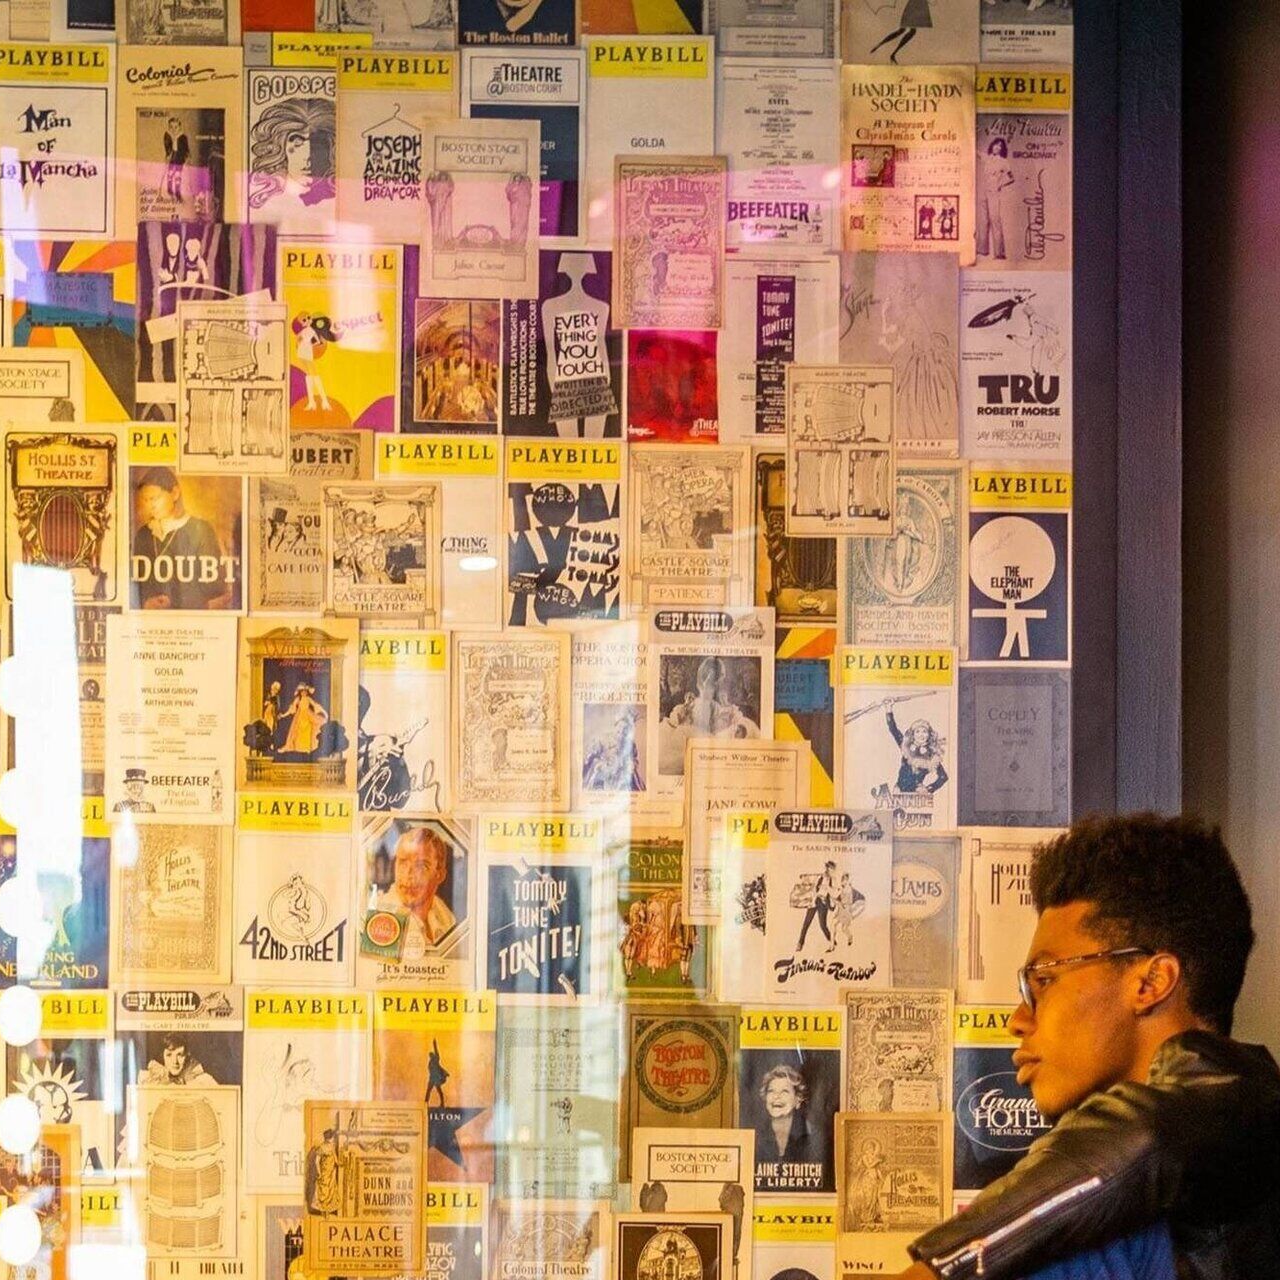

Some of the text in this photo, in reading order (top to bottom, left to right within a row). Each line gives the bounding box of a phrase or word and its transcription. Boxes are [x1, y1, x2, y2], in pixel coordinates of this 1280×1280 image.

[464, 32, 568, 44] The Boston Ballet
[595, 47, 703, 63] PLAYBILL
[343, 58, 449, 75] PLAYBILL
[975, 76, 1066, 94] LAYBILL
[871, 99, 939, 113] SOCIETY
[18, 103, 71, 134] Man
[630, 138, 665, 148] GOLDA
[856, 129, 957, 142] Christmas Carols
[365, 133, 422, 155] JOSEPH
[441, 143, 519, 153] BOSTON STAGE
[457, 154, 505, 166] SOCIETY
[18, 159, 98, 190] Mancha
[727, 201, 809, 223] BEEFEATER
[287, 252, 393, 270] PLAYBILL
[555, 313, 599, 331] EVERY
[558, 329, 597, 343] THING
[559, 344, 598, 360] YOU
[25, 368, 61, 378] STAGE
[556, 360, 604, 377] TOUCH
[978, 374, 1060, 404] TRU
[977, 407, 1061, 416] ROBERT MORSE
[1033, 431, 1061, 441] ALLEN
[27, 452, 76, 467] HOLLIS
[292, 448, 353, 465] UBERT
[385, 444, 494, 460] PLAYBILL
[512, 449, 617, 464] PLAYBILL
[34, 467, 93, 480] THEATRE
[971, 477, 1067, 494] LAYBILL
[572, 527, 619, 546] TOMMY
[570, 546, 620, 566] TOMMY
[130, 555, 240, 584] DOUBT
[1004, 566, 1020, 577] THE
[567, 566, 620, 592] TOMMY
[990, 577, 1034, 589] ELEPHANT
[334, 592, 424, 602] CASTLE SQUARE
[1003, 588, 1022, 600] MAN
[353, 603, 407, 611] THEATRE
[671, 612, 729, 632] PLAYBILL
[360, 640, 441, 656] AYBILL
[133, 651, 206, 662] ANNE BANCROFT
[845, 655, 949, 671] PLAYBILL
[155, 668, 184, 677] GOLDA
[141, 687, 199, 695] WILLIAM GIBSON
[144, 699, 195, 708] ARTHUR PENN
[151, 776, 210, 787] BEEFEATER
[243, 800, 350, 818] PLAYBILL
[489, 822, 595, 838] PLAYBILL
[791, 814, 848, 833] PLAYBILL
[513, 878, 567, 901] TOMMY
[900, 875, 942, 898] JAMES
[513, 906, 548, 929] TUNE
[239, 914, 347, 963] 42ND STREET
[499, 928, 581, 980] TONITE!
[138, 992, 196, 1011] PLAYBILL
[255, 1000, 363, 1015] PLAYBILL
[383, 998, 489, 1013] PLAYBILL
[652, 1040, 706, 1064] BOSTON
[430, 1113, 461, 1121] ILTON
[974, 1108, 1053, 1129] HOTEL
[656, 1153, 732, 1163] BOSTON STAGE
[669, 1163, 717, 1175] SOCIETY
[782, 1163, 822, 1177] STRITCH
[364, 1178, 391, 1189] DUNN
[765, 1178, 820, 1187] LIBERTY
[328, 1226, 403, 1242] PALACE
[329, 1245, 403, 1258] THEATRE
